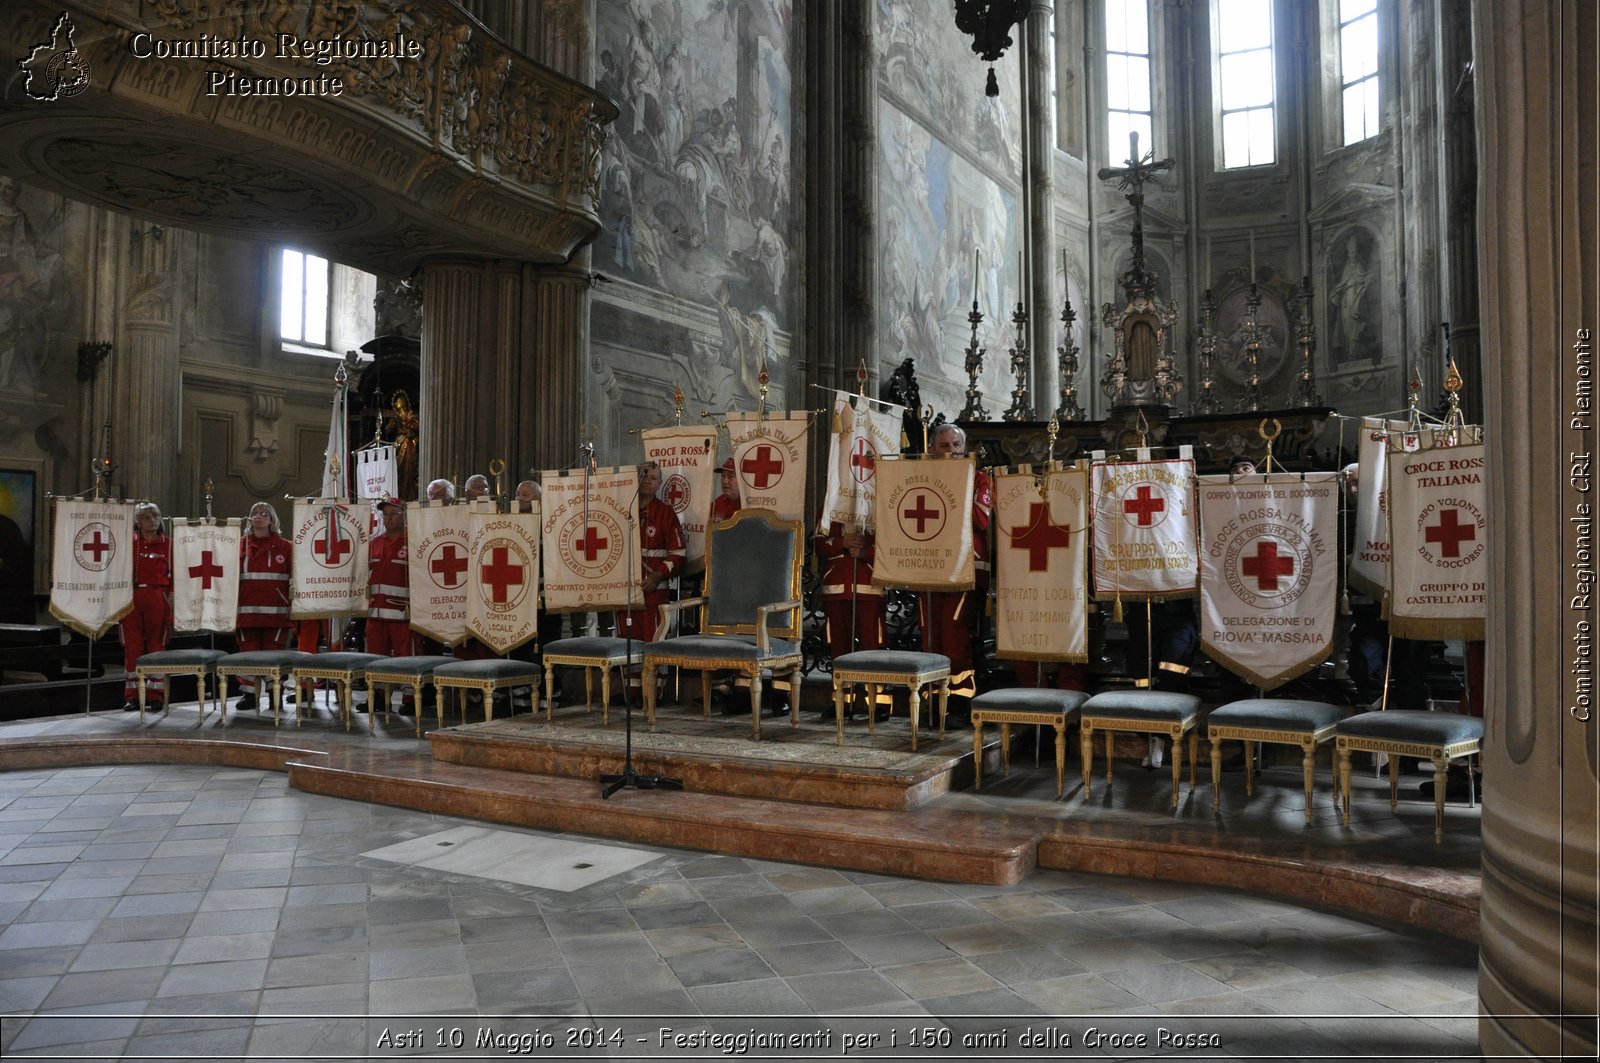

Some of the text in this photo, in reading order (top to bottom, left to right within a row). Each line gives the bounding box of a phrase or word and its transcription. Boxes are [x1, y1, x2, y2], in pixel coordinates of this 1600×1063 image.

[650, 446, 709, 457] CROCE ROSSA
[658, 457, 698, 468] ITALIANA
[1404, 458, 1485, 475] CROCE ROSS
[1417, 474, 1481, 488] ITALIANA
[547, 484, 565, 492] CORPO
[888, 475, 957, 511] CROCE ROSSA ITALIANA
[1206, 489, 1329, 500] CORPO VOLONTARI DEL SOCCORSO
[746, 496, 777, 506] GRUPPO
[544, 504, 567, 534] CROCE
[568, 494, 602, 508] ROSSA
[1438, 497, 1485, 529] VOLONTARI
[294, 520, 314, 545] CROCE
[343, 513, 368, 545] ITALIANA
[570, 519, 578, 528] DI
[609, 523, 619, 533] 22
[682, 523, 704, 533] OCALE
[1210, 508, 1326, 558] CROCE ROSSA ITALIANA
[416, 538, 431, 560] CROCE
[433, 528, 455, 539] ROSSA
[485, 521, 512, 532] ROSSA
[513, 523, 537, 560] ITALIANA
[560, 529, 586, 576] CONVENZIONE
[612, 533, 622, 561] AGOSTO
[1109, 543, 1157, 557] GRUPPO
[889, 549, 953, 558] DELEGAZIONE DI
[1418, 543, 1485, 569] DEL SOCCORSO
[599, 561, 614, 574] 1864
[897, 558, 945, 569] MONCALVO
[1225, 526, 1313, 604] CONVENZIONE DI GINEVRA 22 AGOSTO 1864
[306, 576, 351, 584] DELEGAZIONE
[57, 581, 97, 591] DELEGAZIONE
[545, 583, 585, 592] COMITATO
[1420, 582, 1486, 592] GRUPPO DI
[295, 590, 348, 599] MONTEGROSSO
[578, 593, 609, 602] ASTI
[1044, 588, 1083, 601] LOCALE
[1406, 594, 1486, 605] CASTELL'ALFE
[430, 596, 467, 605] DELEGAZIO
[431, 611, 467, 620] ISOLA D'AS
[486, 612, 517, 622] COMITATO
[1029, 609, 1071, 623] DAMIANO
[1223, 617, 1315, 626] DELEGAZIONE DI
[472, 617, 531, 646] VILLANOVA D'ASTI
[489, 623, 513, 632] LOCALE
[1213, 631, 1325, 644] PIOVA' MASSAIA
